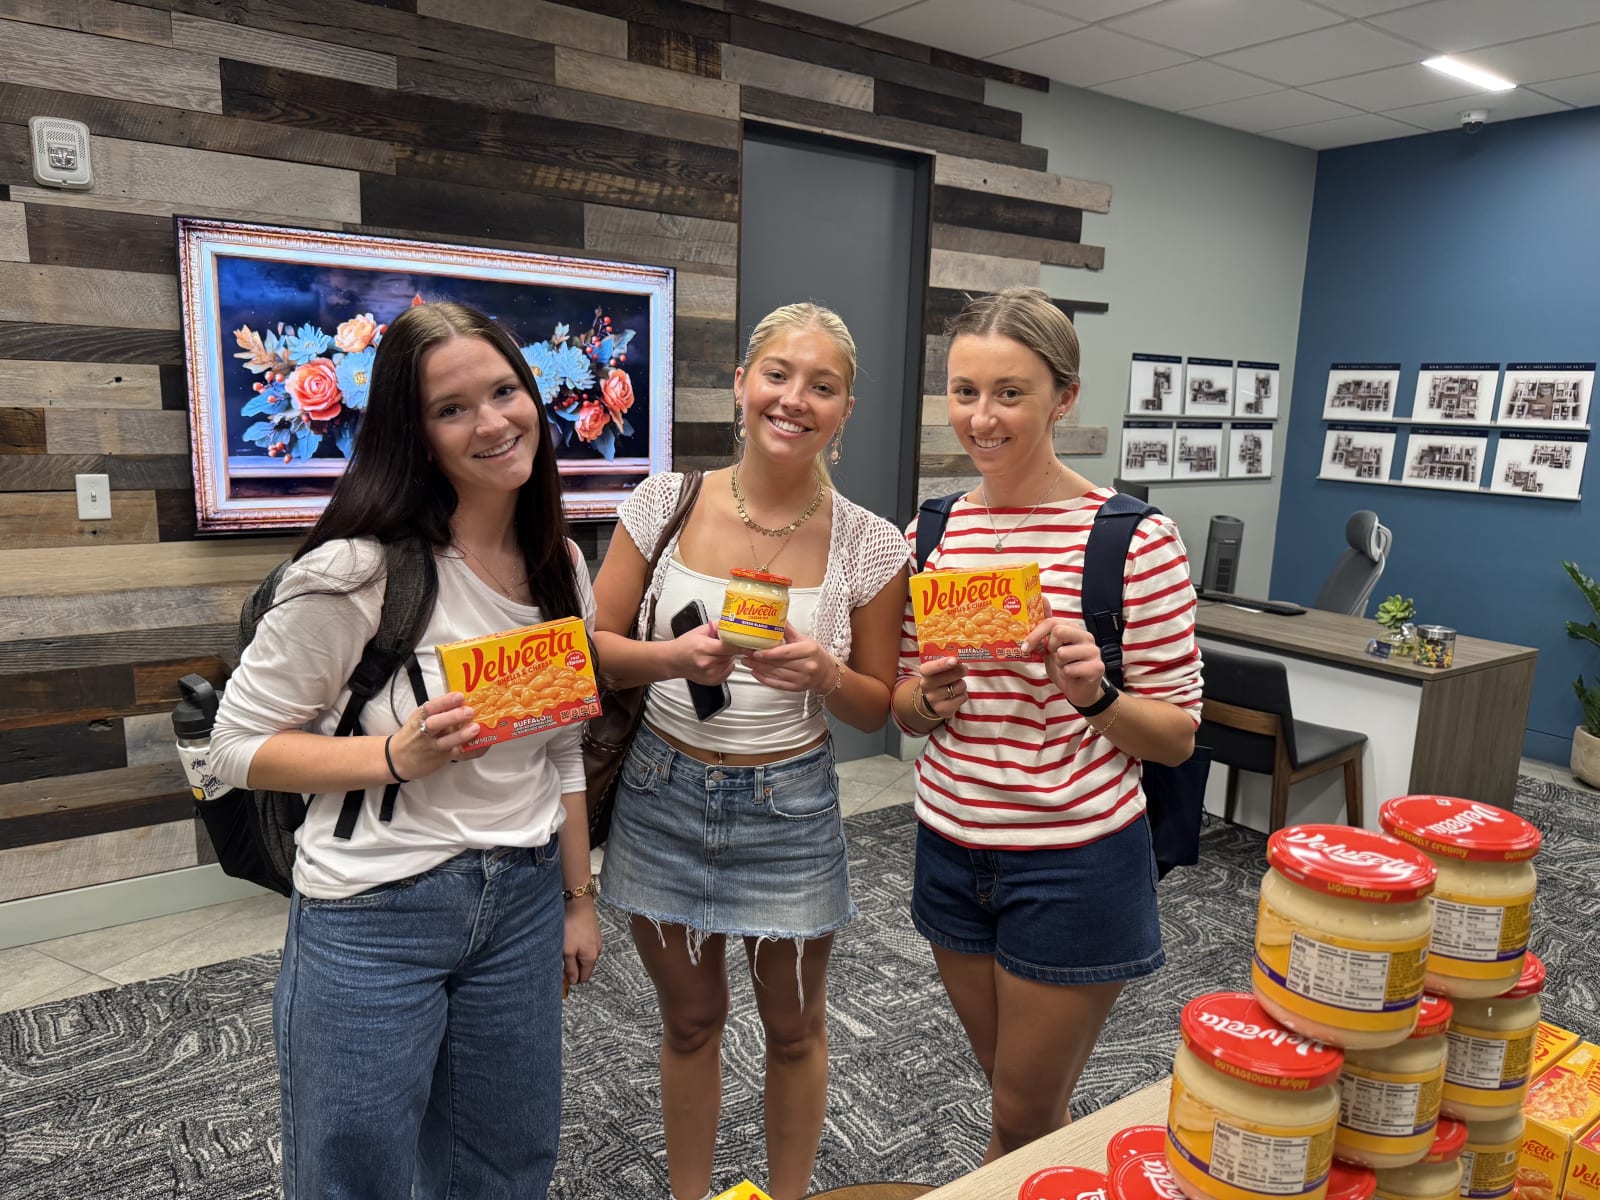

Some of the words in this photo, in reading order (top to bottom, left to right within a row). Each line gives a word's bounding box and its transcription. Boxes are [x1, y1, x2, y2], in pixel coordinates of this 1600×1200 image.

[736, 600, 778, 616] Velveeta
[922, 572, 1012, 616] Velveeta
[462, 628, 575, 692] Velveeta
[497, 672, 521, 686] SHELLS
[528, 659, 553, 673] CHEESE
[566, 658, 585, 666] cheese
[513, 715, 547, 729] BUFFALO
[1426, 804, 1504, 835] Velveeta
[1286, 832, 1419, 879] Velveeta
[1393, 827, 1430, 847] SUPREMELY
[1431, 841, 1469, 859] creamy
[1327, 882, 1357, 896] LIQUID
[1359, 887, 1393, 902] luxury
[1214, 1058, 1277, 1085] OUTRAGEOUSLY
[1279, 1077, 1311, 1089] drippy
[1572, 1163, 1600, 1186] Velv
